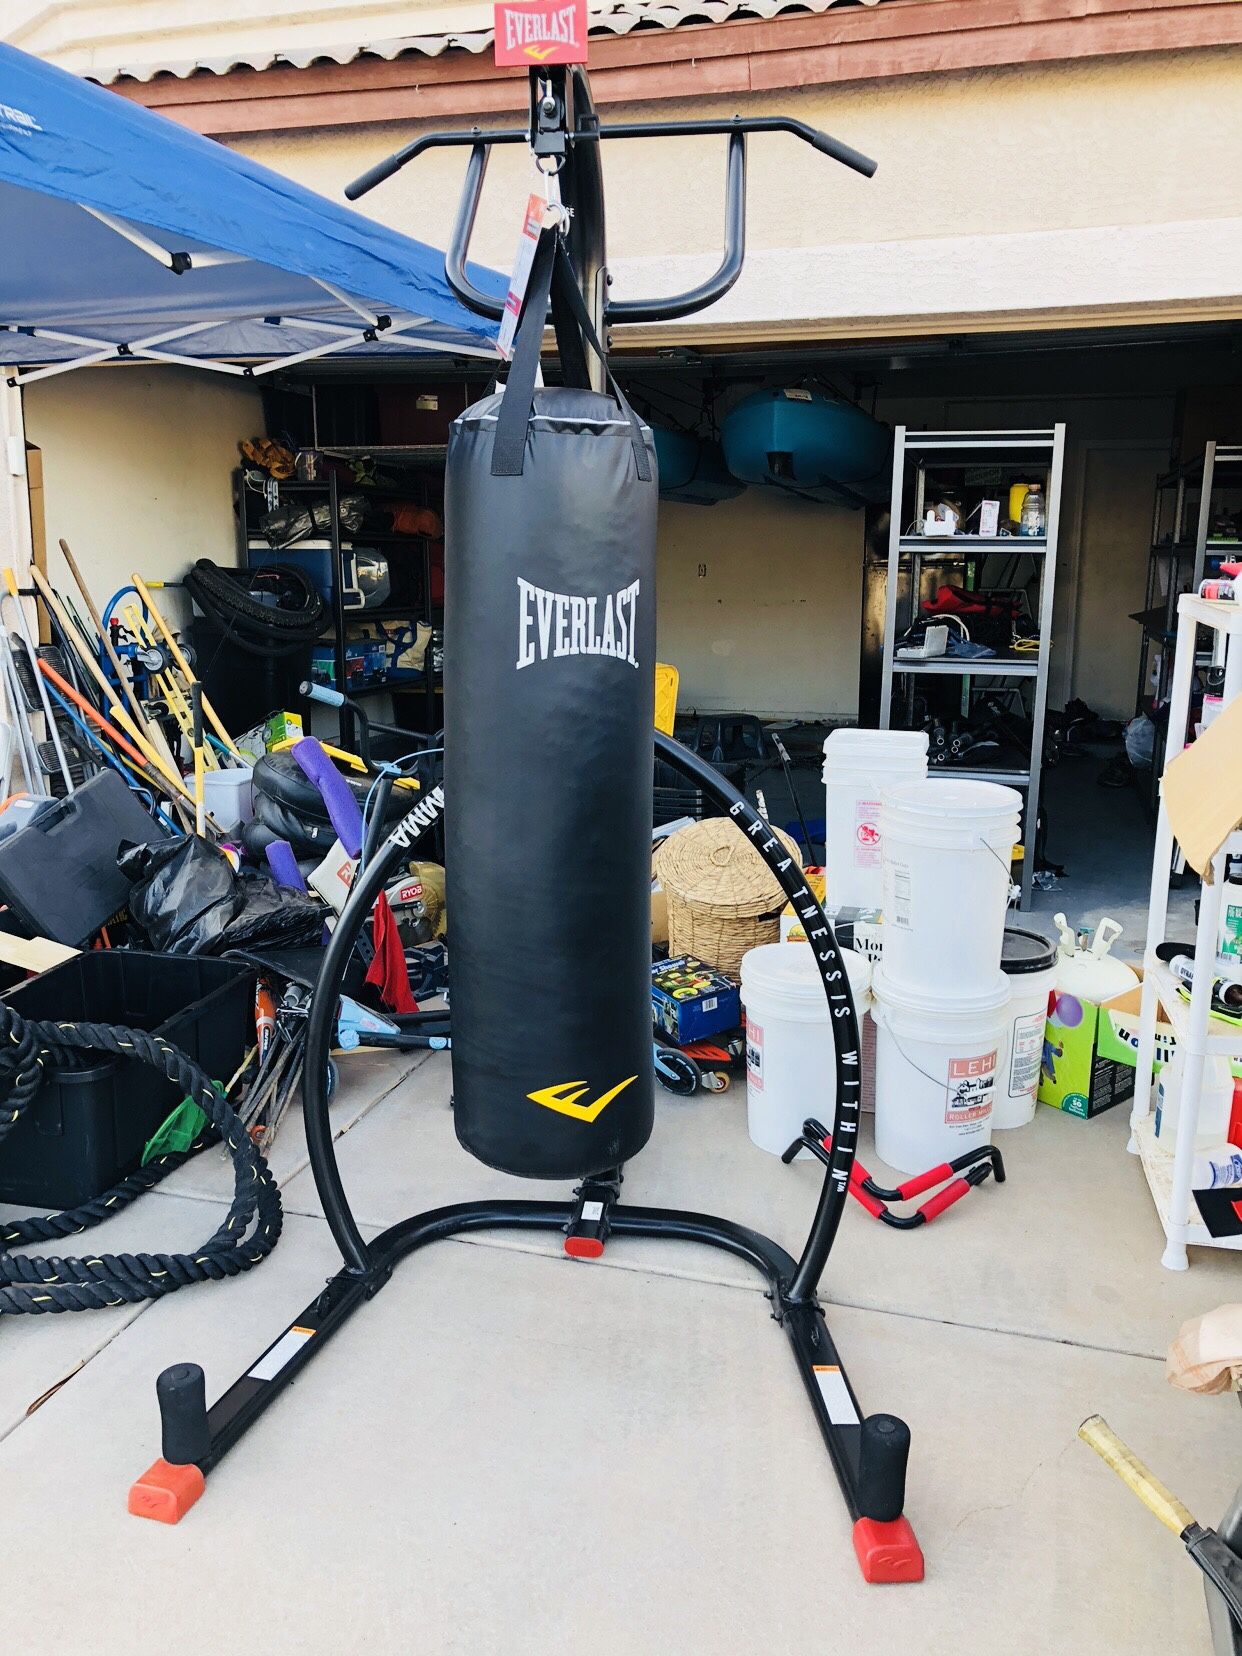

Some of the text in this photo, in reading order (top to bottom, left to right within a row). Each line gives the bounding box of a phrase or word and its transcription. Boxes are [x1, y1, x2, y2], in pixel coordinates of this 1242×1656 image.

[504, 4, 577, 51] EVERLAST
[516, 576, 640, 669] EVERLAST
[389, 785, 445, 848] MMA
[402, 885, 422, 899] RYOB
[729, 801, 842, 982] GREATNESS
[831, 994, 850, 1018] IS
[953, 1054, 996, 1076] LEHI
[832, 1050, 859, 1181] WITHIN
